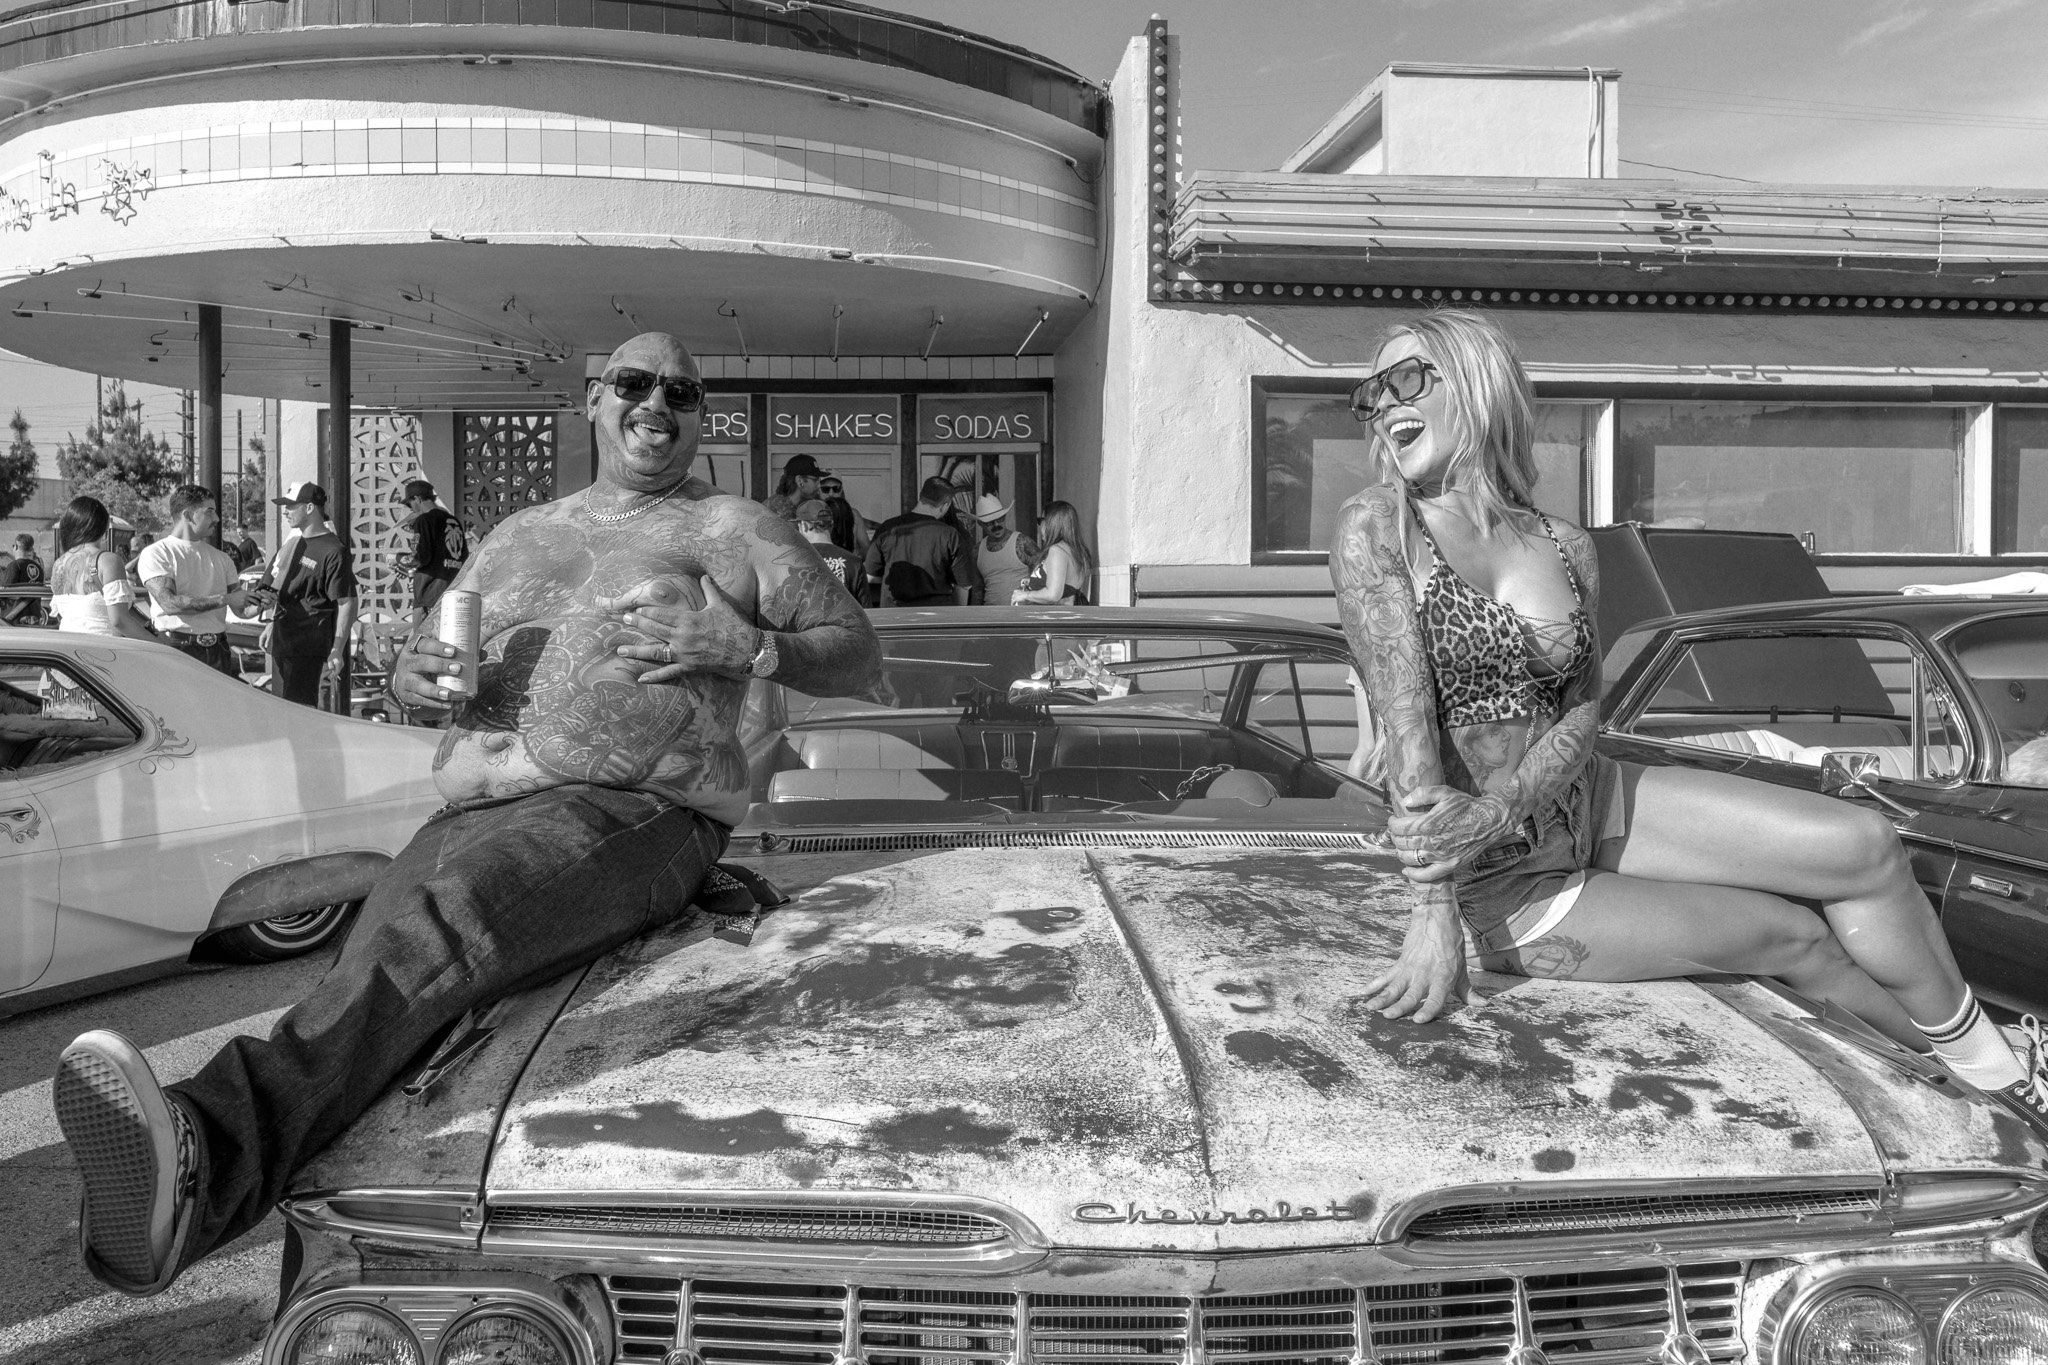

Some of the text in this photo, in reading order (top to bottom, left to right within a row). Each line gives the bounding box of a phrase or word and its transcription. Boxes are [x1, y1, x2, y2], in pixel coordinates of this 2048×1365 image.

[775, 413, 893, 438] SHAKES
[934, 414, 1032, 439] SODAS
[1071, 1199, 1357, 1224] Chevrolet
